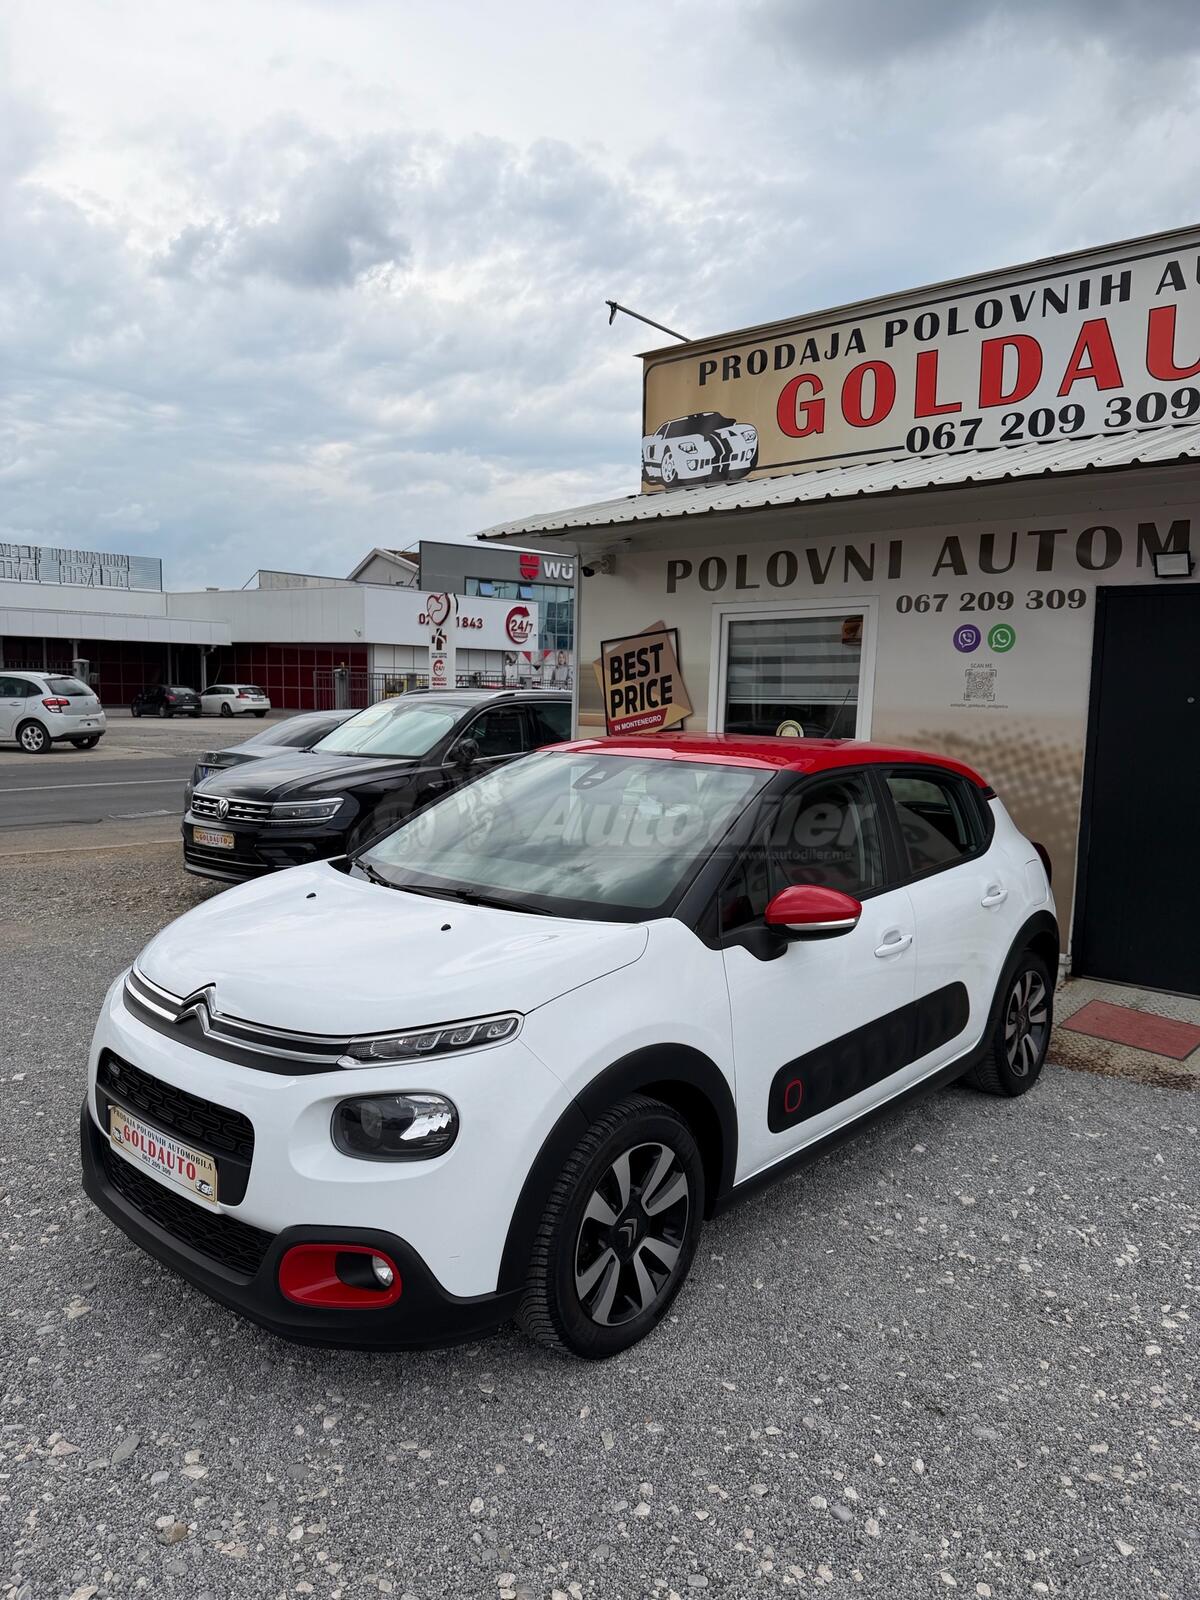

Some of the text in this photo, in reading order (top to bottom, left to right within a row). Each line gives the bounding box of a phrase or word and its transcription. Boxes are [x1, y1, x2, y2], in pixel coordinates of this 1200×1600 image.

[699, 256, 1200, 386] PRODAJA POLOVNIH A
[776, 304, 1200, 438] GOLDAU
[906, 387, 1200, 453] 067 209 309
[666, 519, 1191, 593] POLOVNI AUTOM
[456, 616, 483, 629] 1843
[896, 588, 1087, 613] 067 209 309
[511, 619, 534, 633] 24/7
[610, 642, 664, 685] BEST
[610, 674, 673, 718] PRICE
[621, 714, 662, 730] MONTENEGRO
[113, 1108, 213, 1171] PRODAJA POLOVNIH AUTOMOBILA
[123, 1124, 196, 1181] GOLDAUTO
